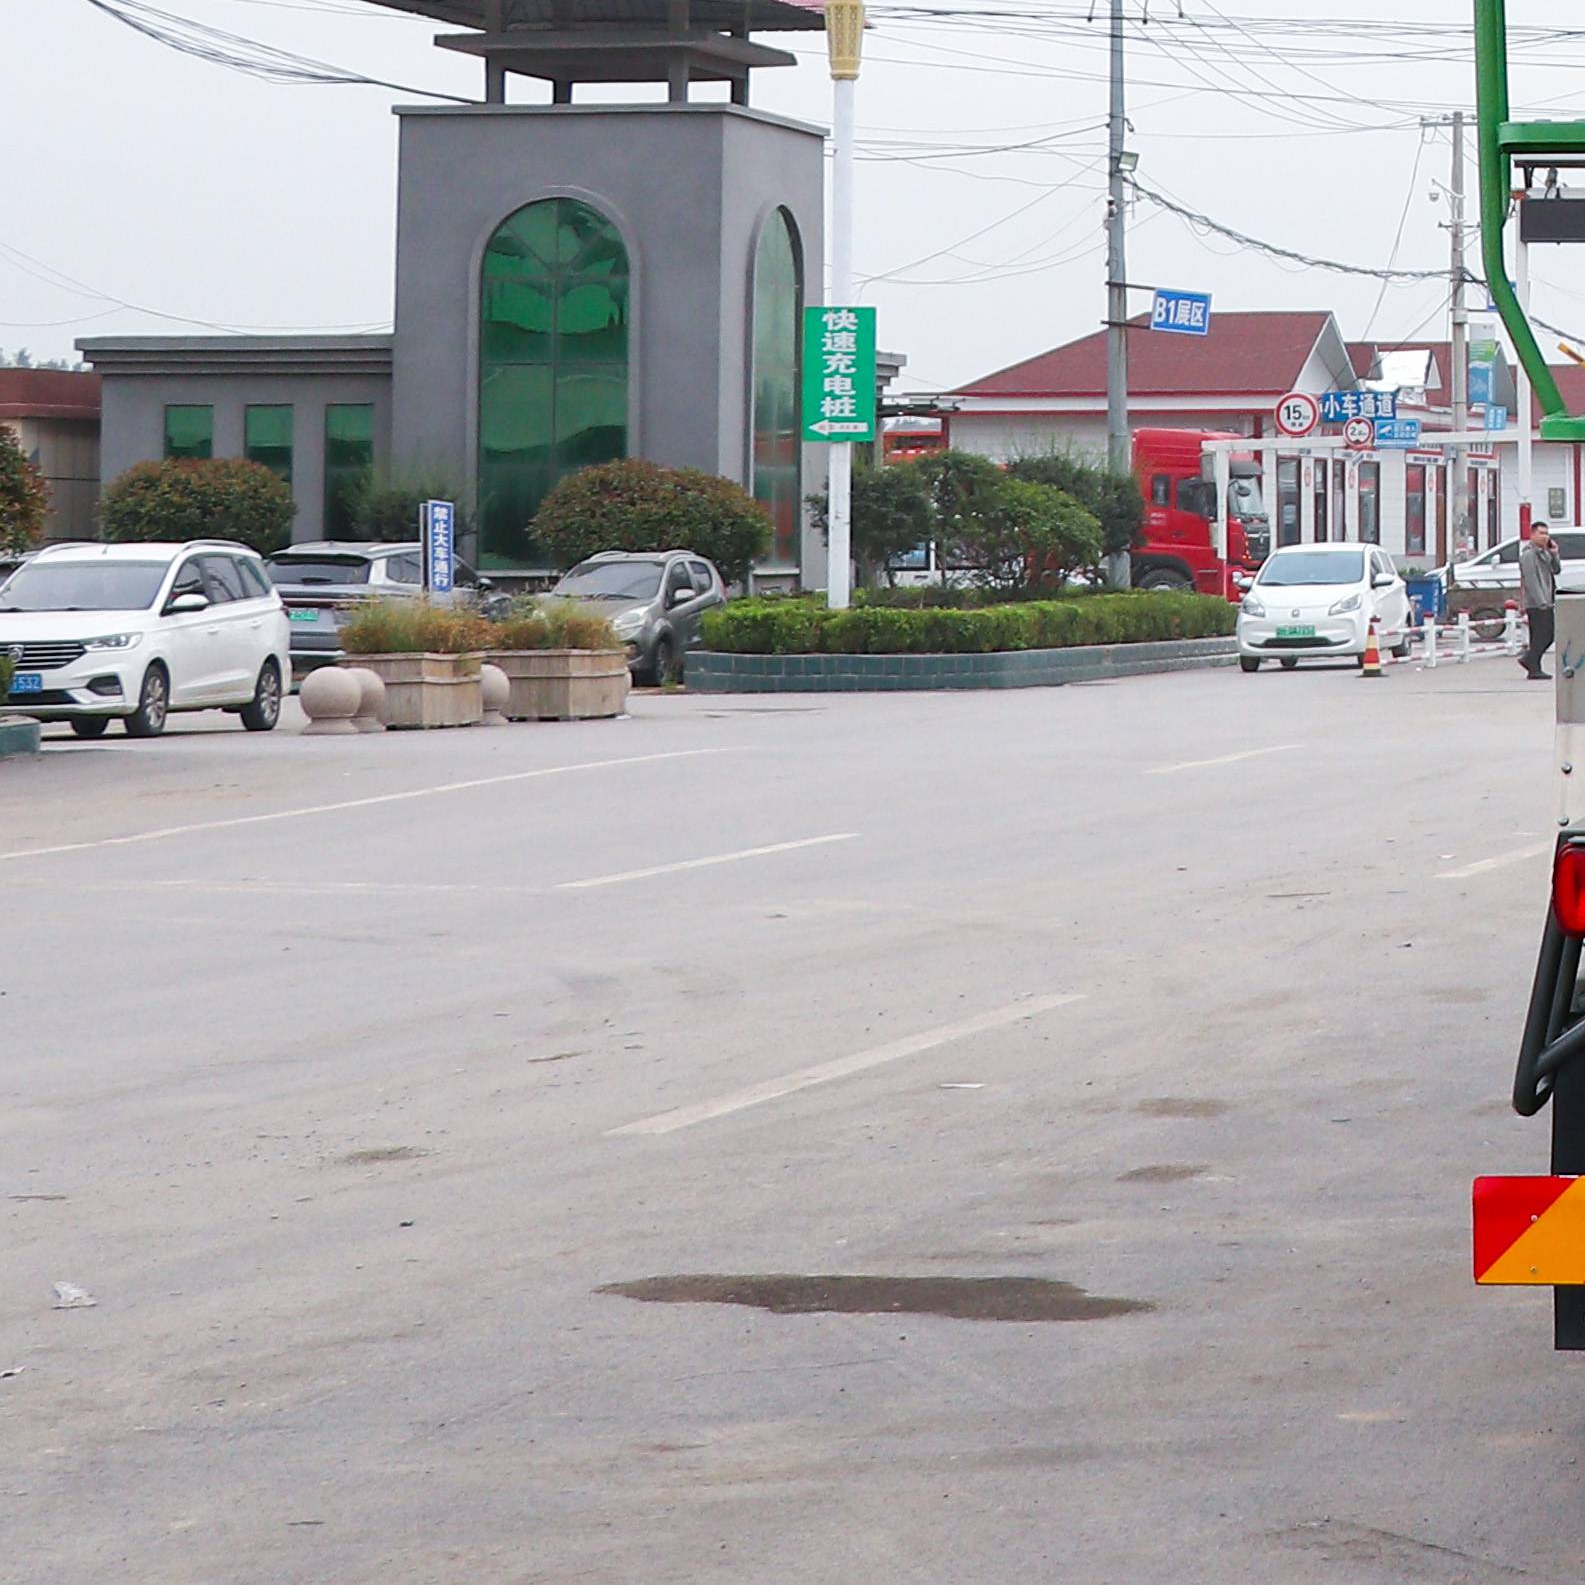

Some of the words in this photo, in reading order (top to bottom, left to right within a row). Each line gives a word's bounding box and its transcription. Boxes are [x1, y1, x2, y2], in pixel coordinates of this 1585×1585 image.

[1154, 297, 1206, 327] B1展区
[820, 309, 859, 418] 快速充电桩
[1324, 393, 1394, 418] 小车通道
